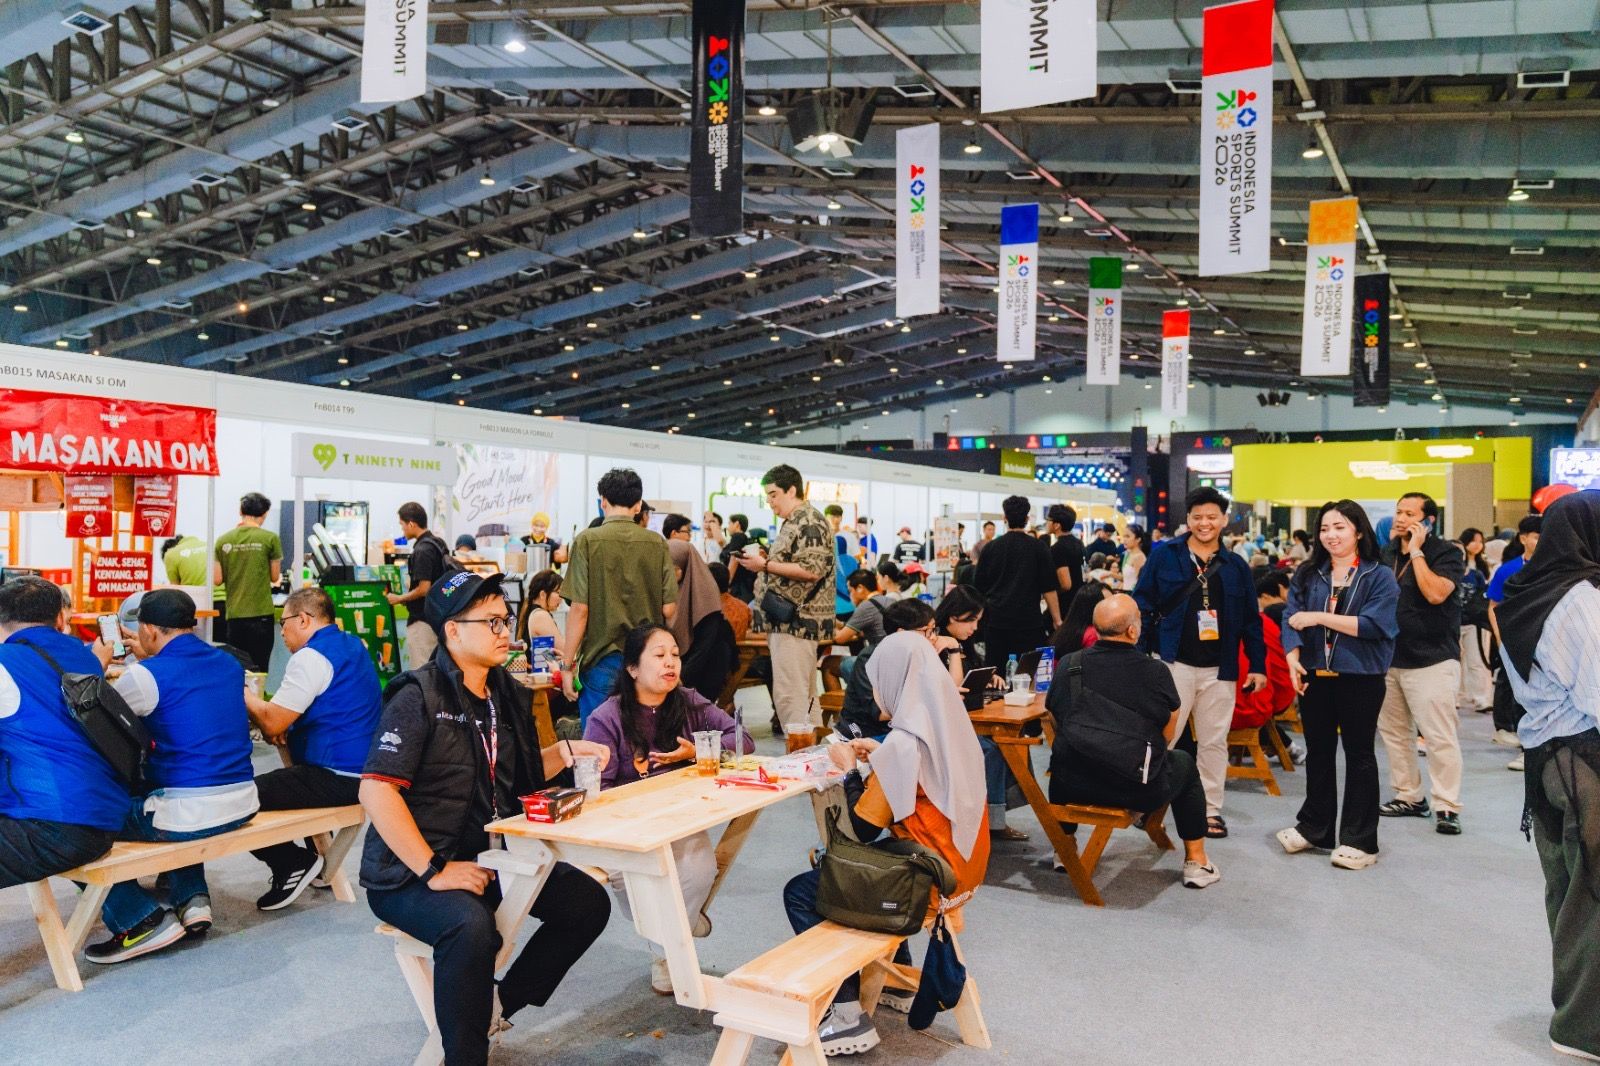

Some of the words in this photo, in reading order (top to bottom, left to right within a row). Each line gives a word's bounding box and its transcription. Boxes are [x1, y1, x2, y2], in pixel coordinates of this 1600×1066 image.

[394, 0, 406, 76] SUMMIT
[1030, 0, 1048, 73] MMIT
[1215, 136, 1228, 186] 2026
[1230, 134, 1242, 192] SPORTS
[1244, 130, 1256, 214] INDONESIA
[1228, 196, 1242, 256] SUMMIT
[1314, 285, 1324, 318] 2026
[1324, 285, 1334, 322] SPORTS
[1332, 282, 1343, 337] INDONESIA
[1321, 324, 1332, 362] SUMMIT
[36, 368, 92, 385] MASAKAN
[96, 376, 104, 385] SI
[108, 378, 126, 388] OM
[314, 402, 340, 412] FnB014
[342, 406, 355, 414] T99
[11, 431, 163, 468] MASAKAN
[170, 442, 210, 471] OM
[343, 454, 349, 464] T
[355, 455, 404, 468] NINETY
[410, 460, 441, 471] NINE
[461, 473, 498, 499] Good
[498, 464, 526, 488] Mood
[467, 494, 504, 521] Starts
[505, 492, 533, 512] Here
